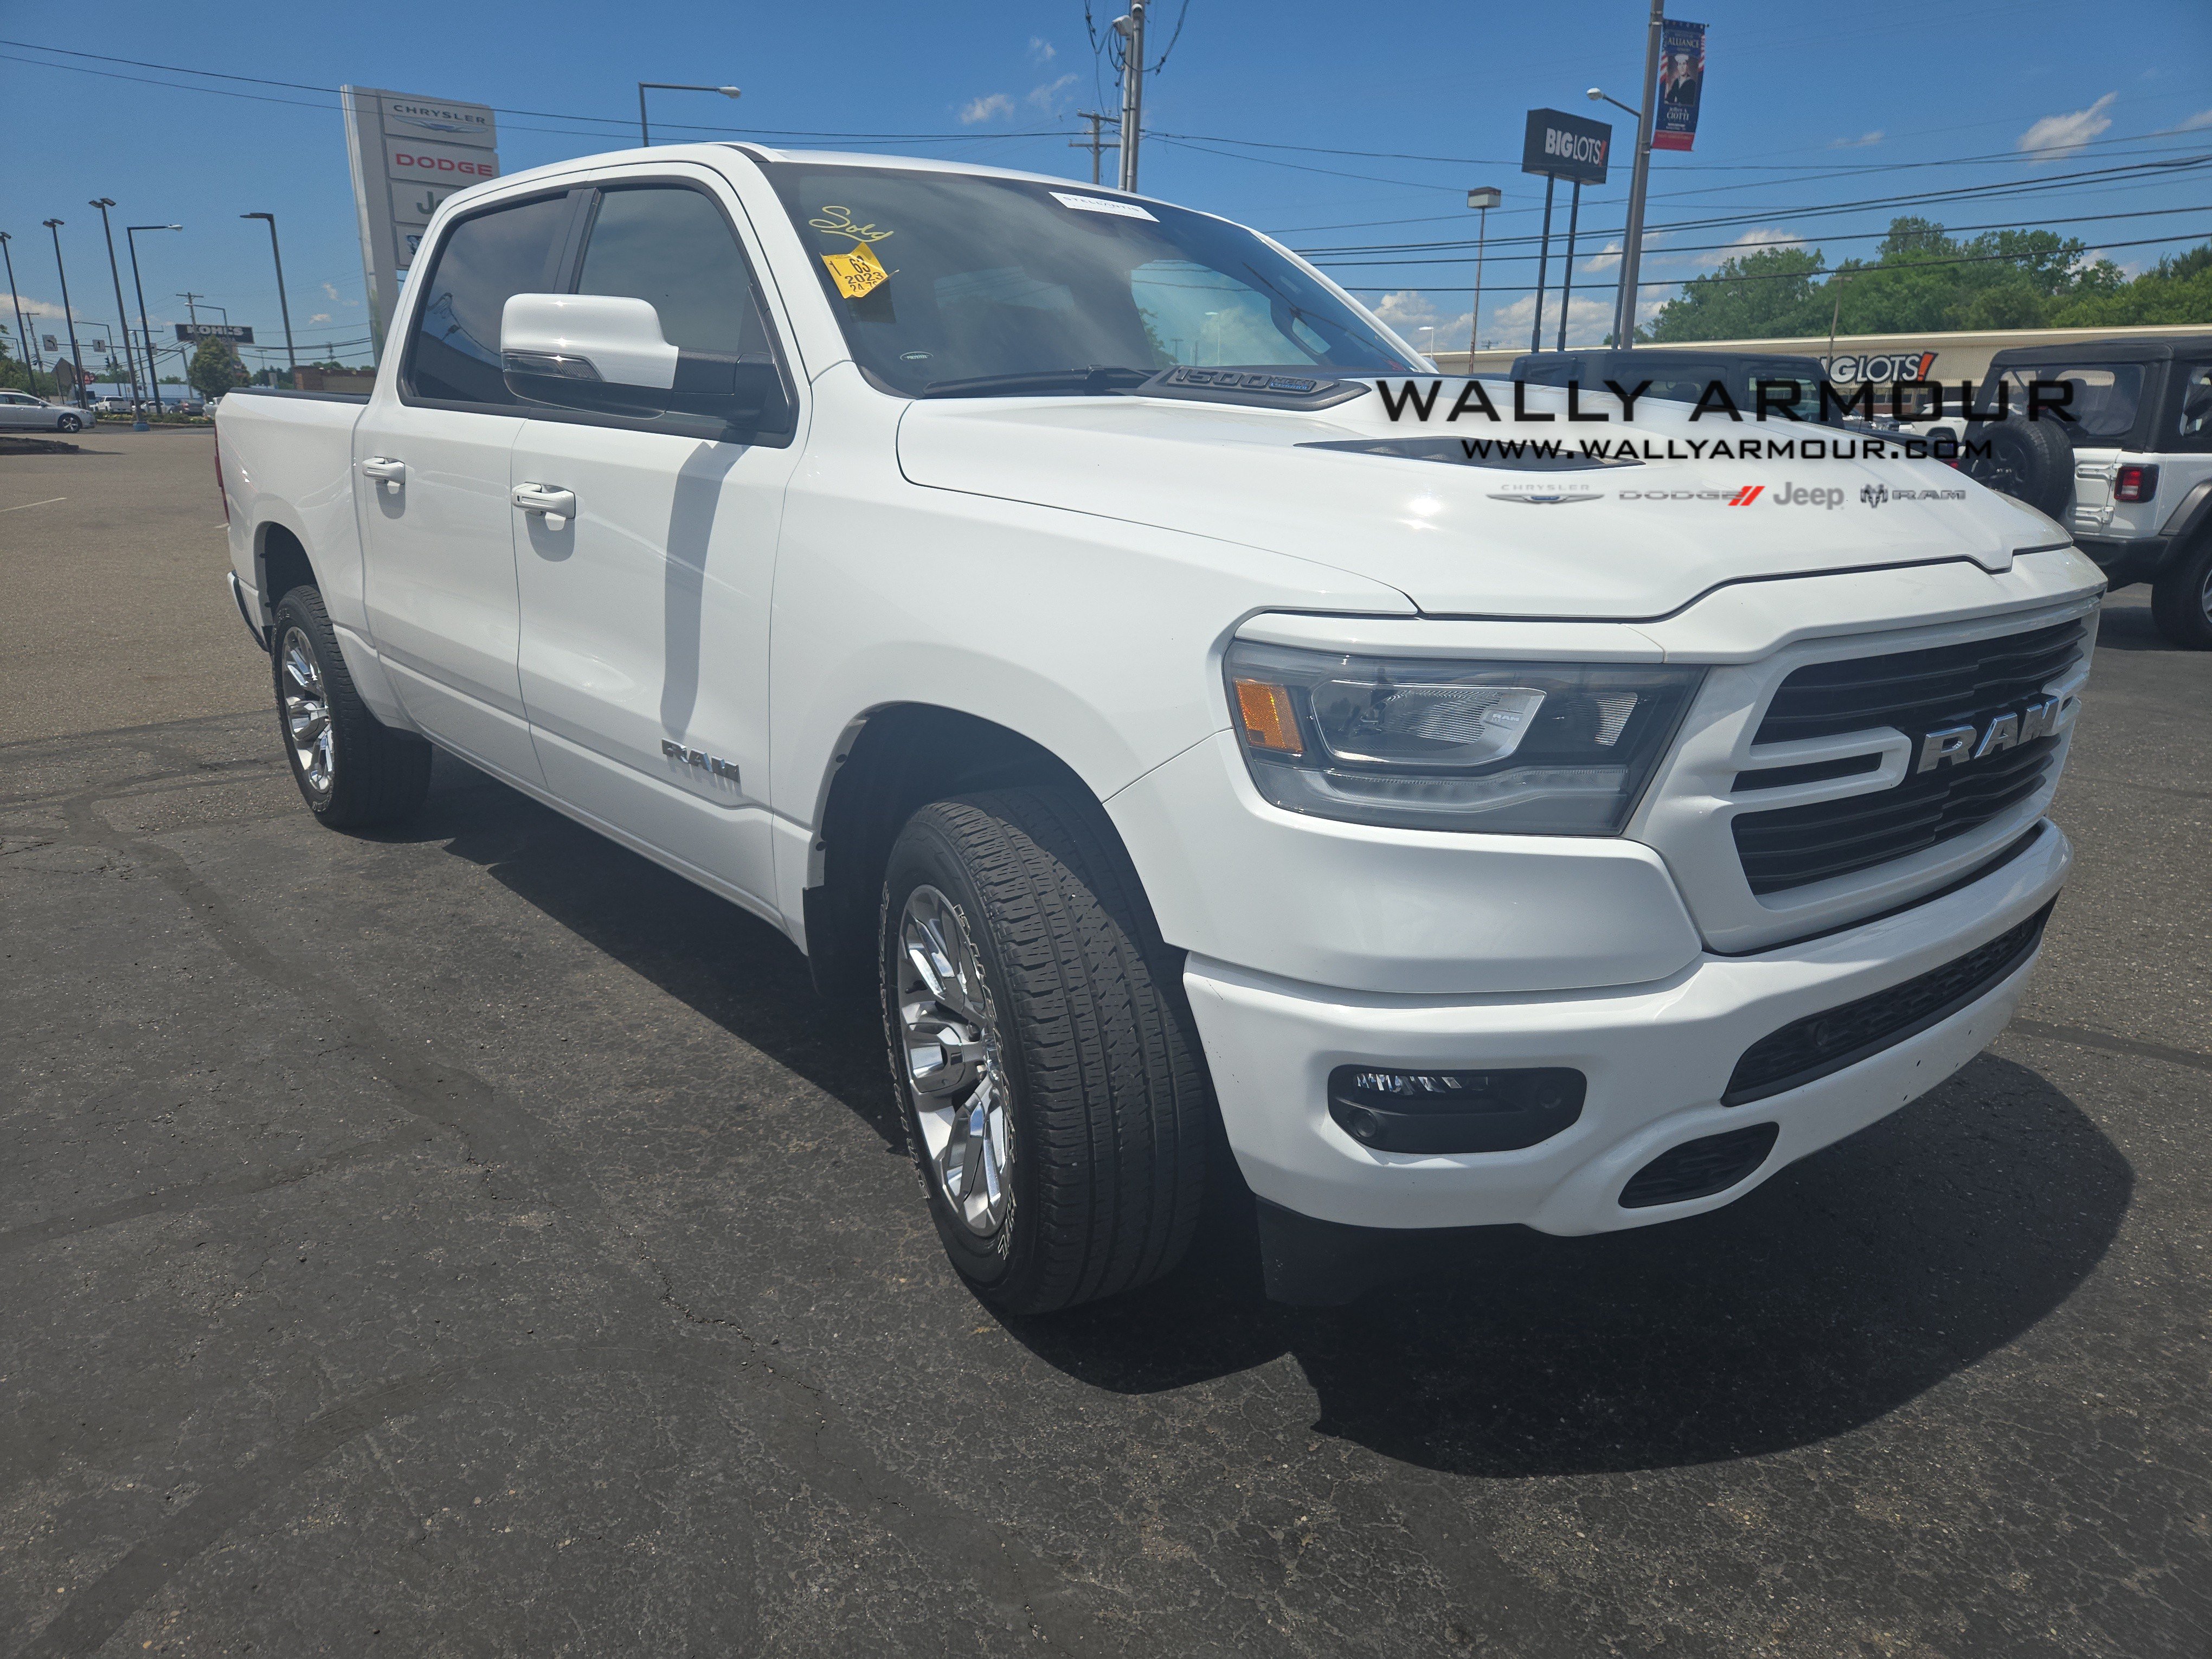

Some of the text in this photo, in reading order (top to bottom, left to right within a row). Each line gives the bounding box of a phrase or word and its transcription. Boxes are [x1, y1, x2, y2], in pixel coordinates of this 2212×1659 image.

[394, 105, 486, 124] CHRYSLER
[396, 153, 493, 177] DODGE
[809, 205, 895, 242] Sold
[844, 272, 884, 285] 2023
[1175, 368, 1271, 389] 1500
[1917, 697, 2059, 774] RAM
[661, 737, 741, 784] RAM
